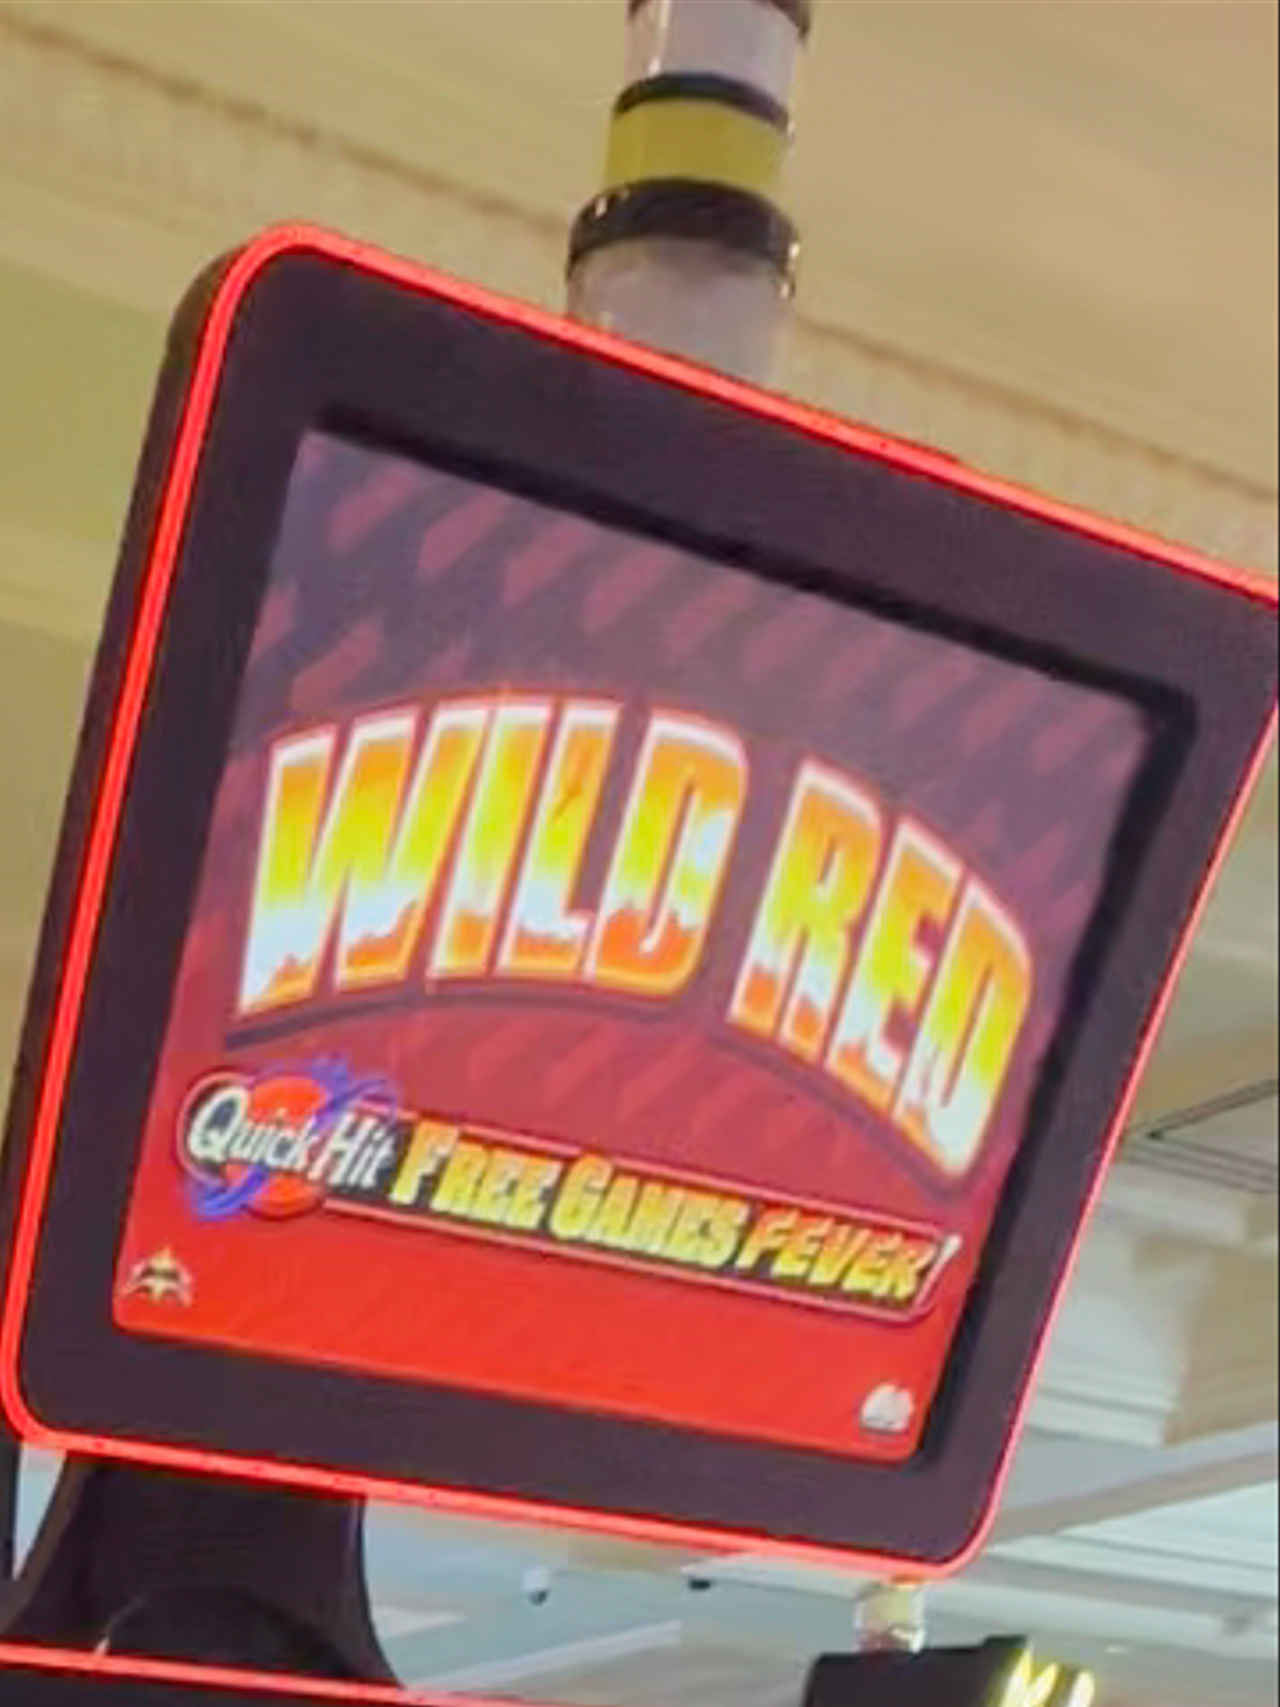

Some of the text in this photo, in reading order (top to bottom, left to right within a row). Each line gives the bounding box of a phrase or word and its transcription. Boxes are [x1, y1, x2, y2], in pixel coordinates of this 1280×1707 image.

[236, 697, 1033, 1180] WILD RED
[186, 1087, 313, 1172] Quick
[312, 1109, 399, 1189] Hit
[390, 1121, 561, 1229] FREE
[550, 1154, 752, 1268] GAMES
